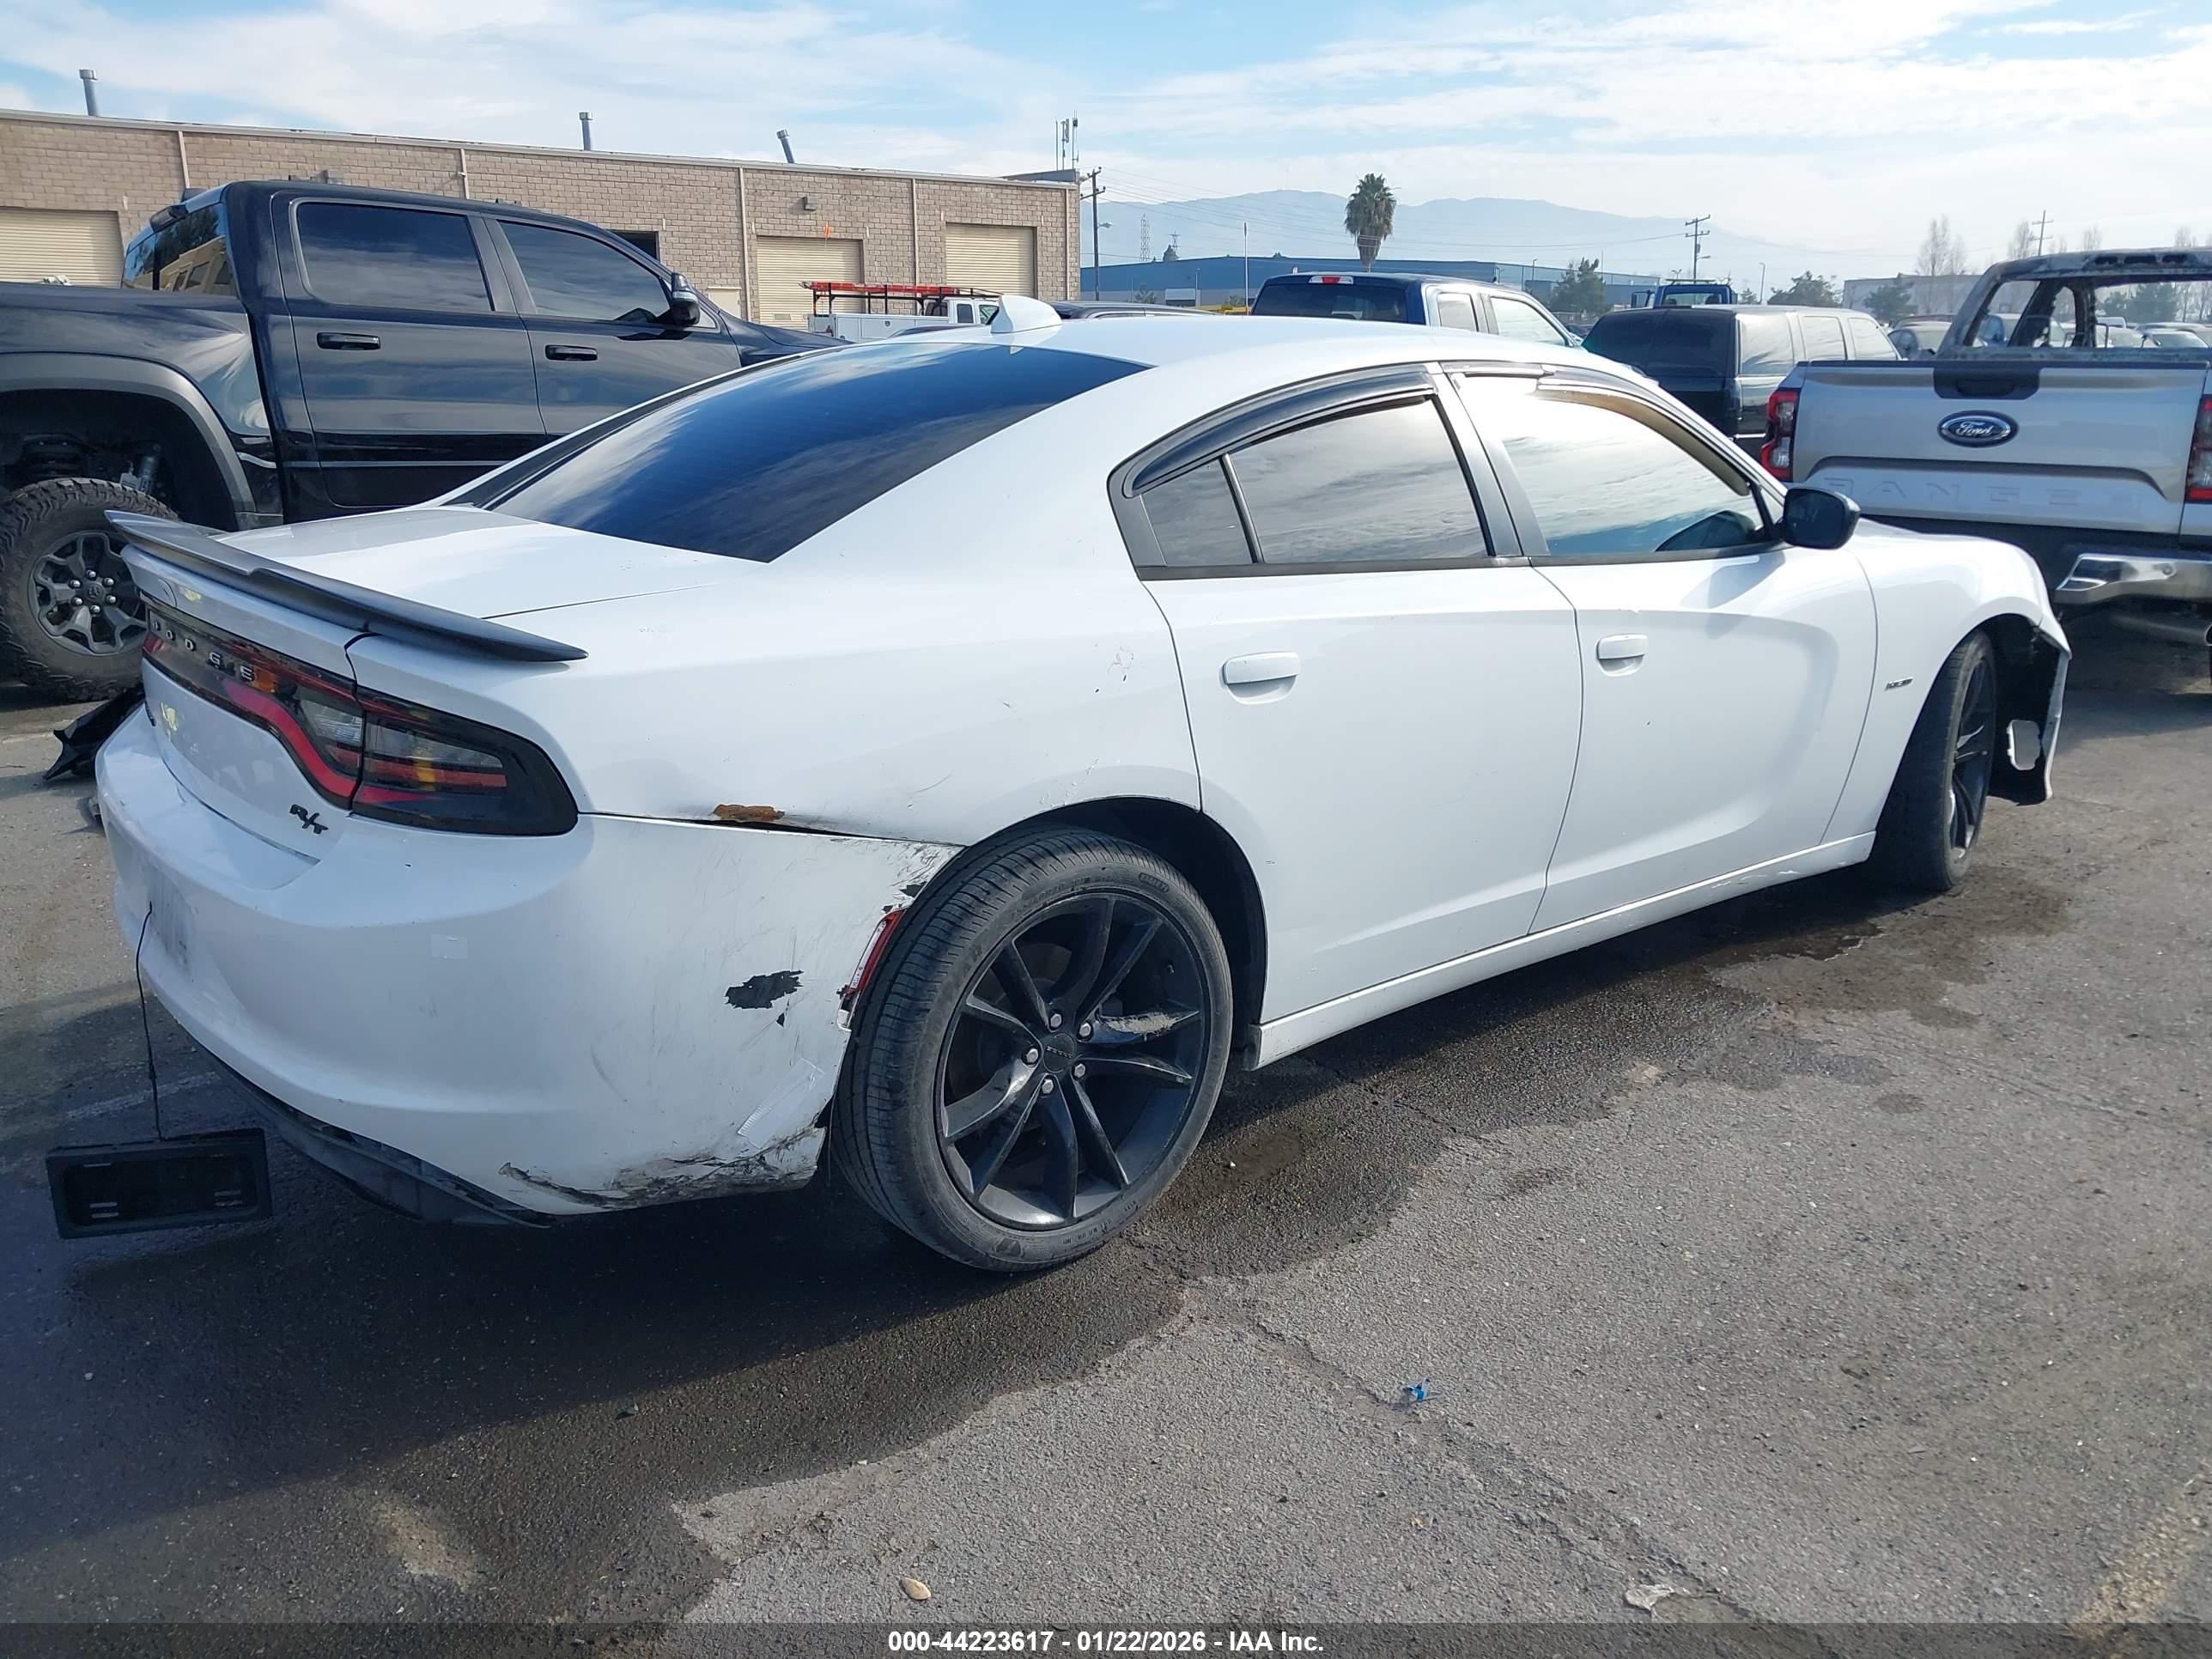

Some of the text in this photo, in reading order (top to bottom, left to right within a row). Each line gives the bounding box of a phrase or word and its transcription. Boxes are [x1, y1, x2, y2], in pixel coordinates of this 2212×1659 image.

[1955, 421, 1994, 437] Ford
[1823, 477, 2145, 510] RANGE
[152, 620, 254, 681] DODGE
[289, 804, 329, 835] R/T
